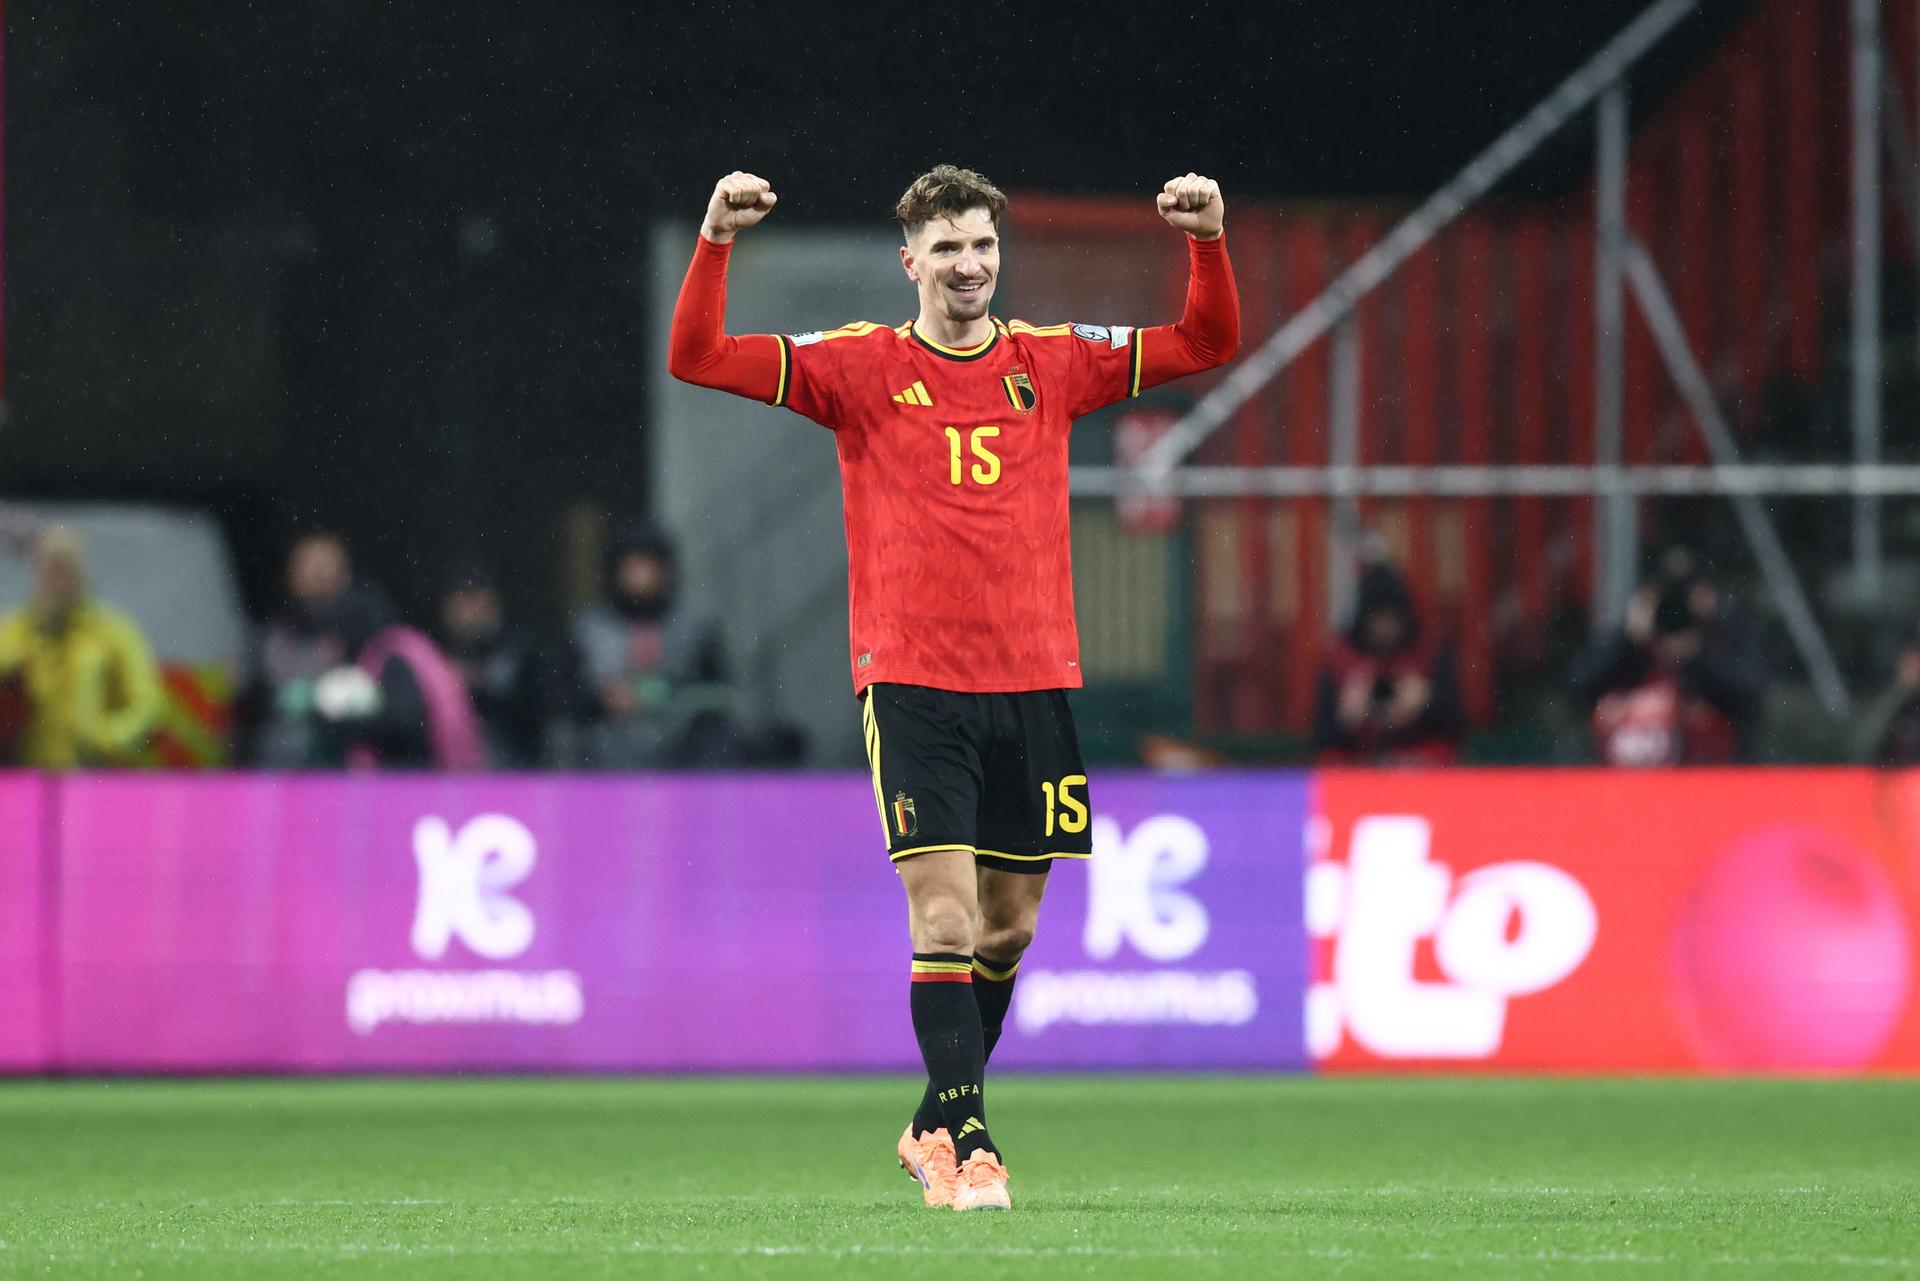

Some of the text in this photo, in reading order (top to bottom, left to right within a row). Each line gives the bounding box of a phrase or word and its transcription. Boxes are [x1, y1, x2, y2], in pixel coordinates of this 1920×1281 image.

[944, 426, 1001, 485] 15
[1041, 774, 1088, 837] 15
[347, 969, 583, 1034] proximus
[1017, 970, 1257, 1034] proximus
[938, 1083, 980, 1104] RBFA
